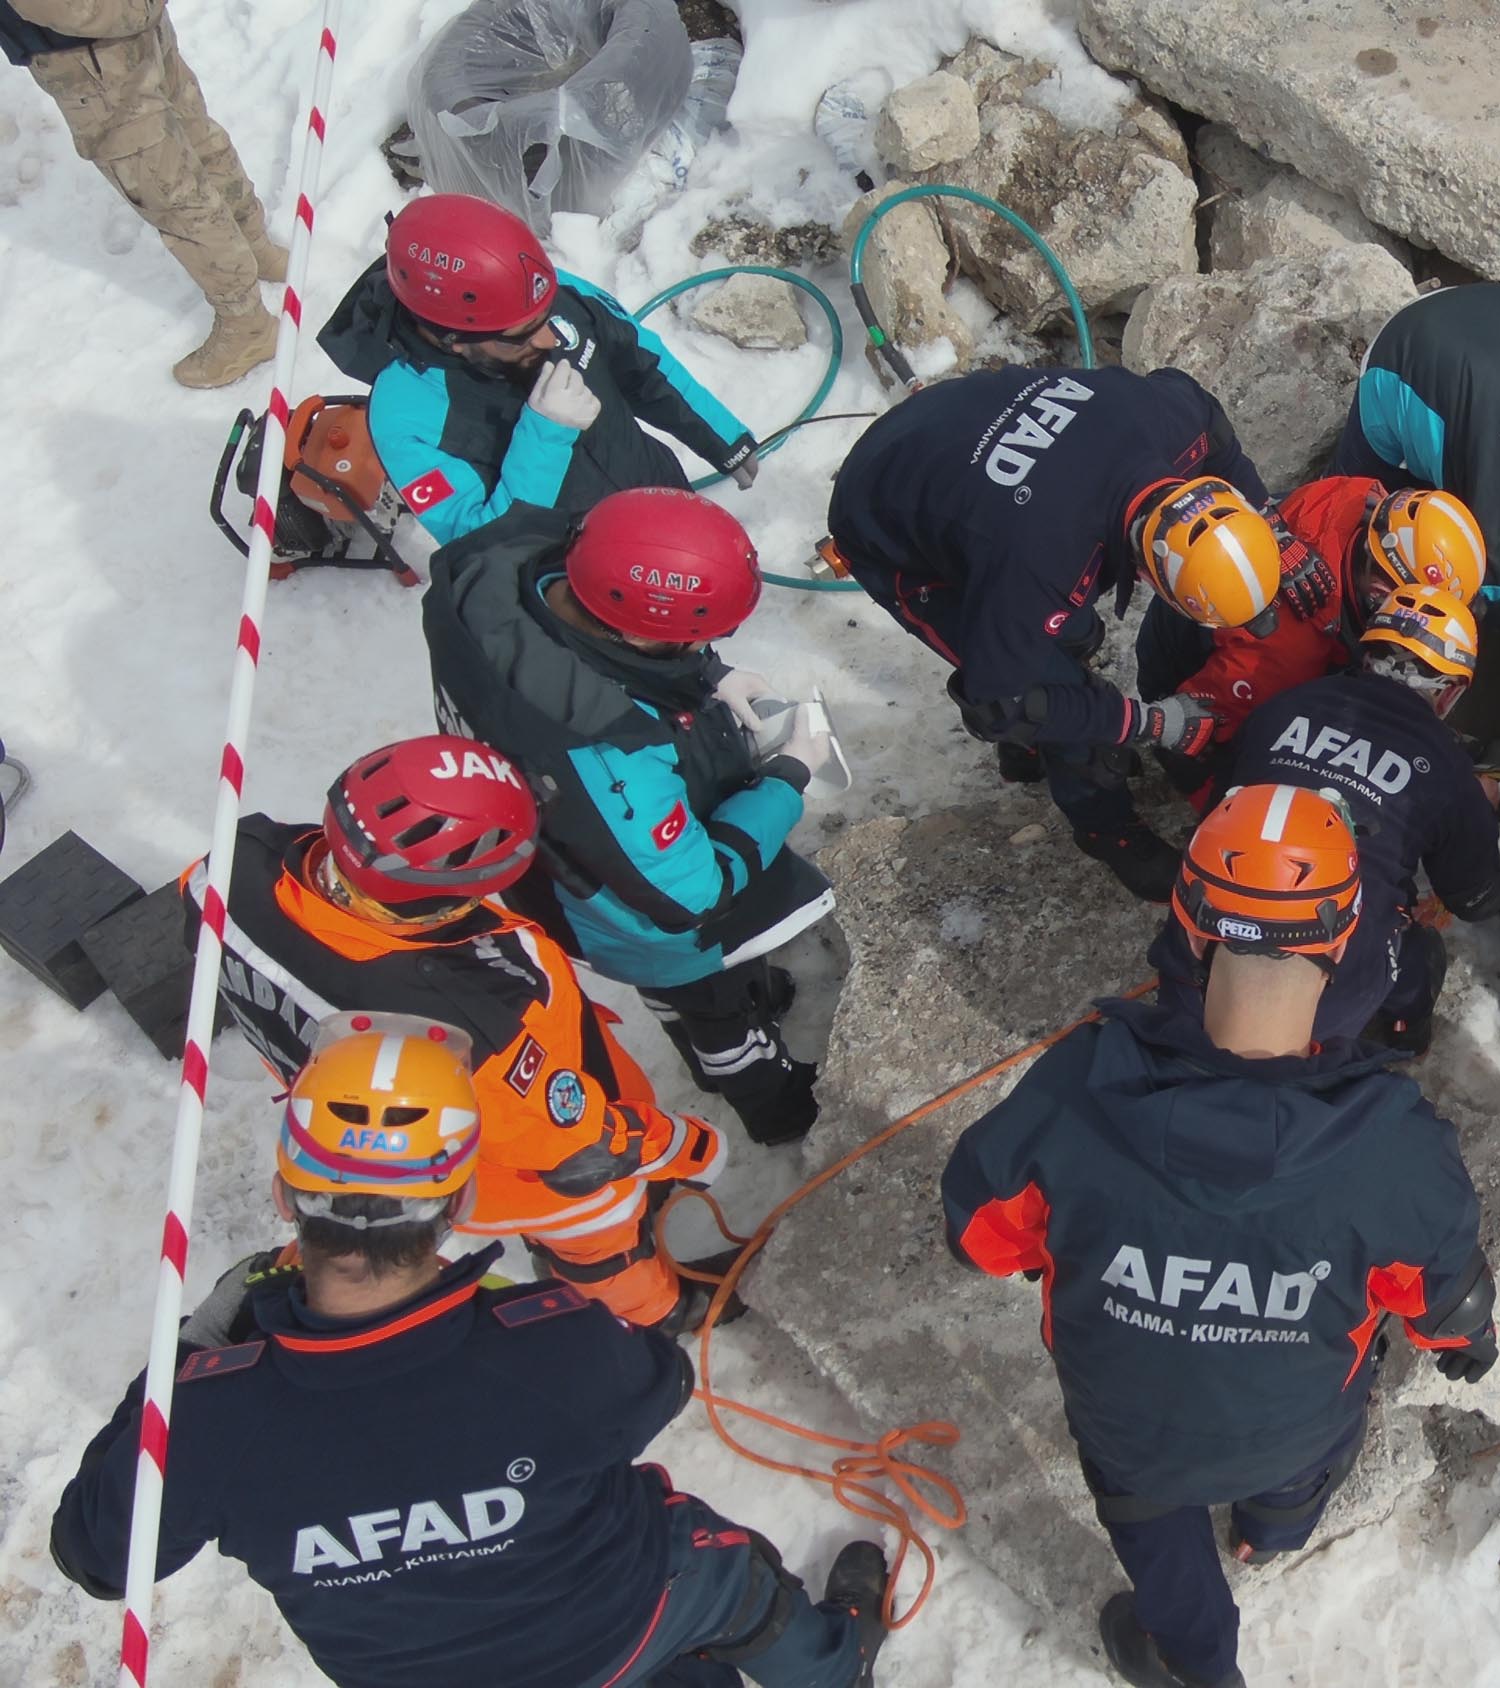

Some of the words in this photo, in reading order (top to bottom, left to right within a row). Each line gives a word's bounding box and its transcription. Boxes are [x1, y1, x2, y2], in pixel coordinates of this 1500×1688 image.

[408, 243, 465, 273] CAMP
[970, 407, 1014, 465] KURTARMA
[985, 376, 1095, 487] AFAD
[630, 565, 701, 592] CAMP
[429, 751, 522, 790] JAK
[1269, 716, 1411, 794] AFAD
[1269, 757, 1310, 772] ARAMA
[1320, 768, 1382, 806] KURTARMA
[1218, 919, 1263, 941] PETZL
[339, 1128, 410, 1153] AFAD
[1100, 1244, 1318, 1321] AFAD
[1103, 1297, 1174, 1336] ARAMA
[1191, 1324, 1310, 1344] KURTARMA
[292, 1486, 526, 1574] AFAD
[313, 1569, 391, 1588] ARAMA
